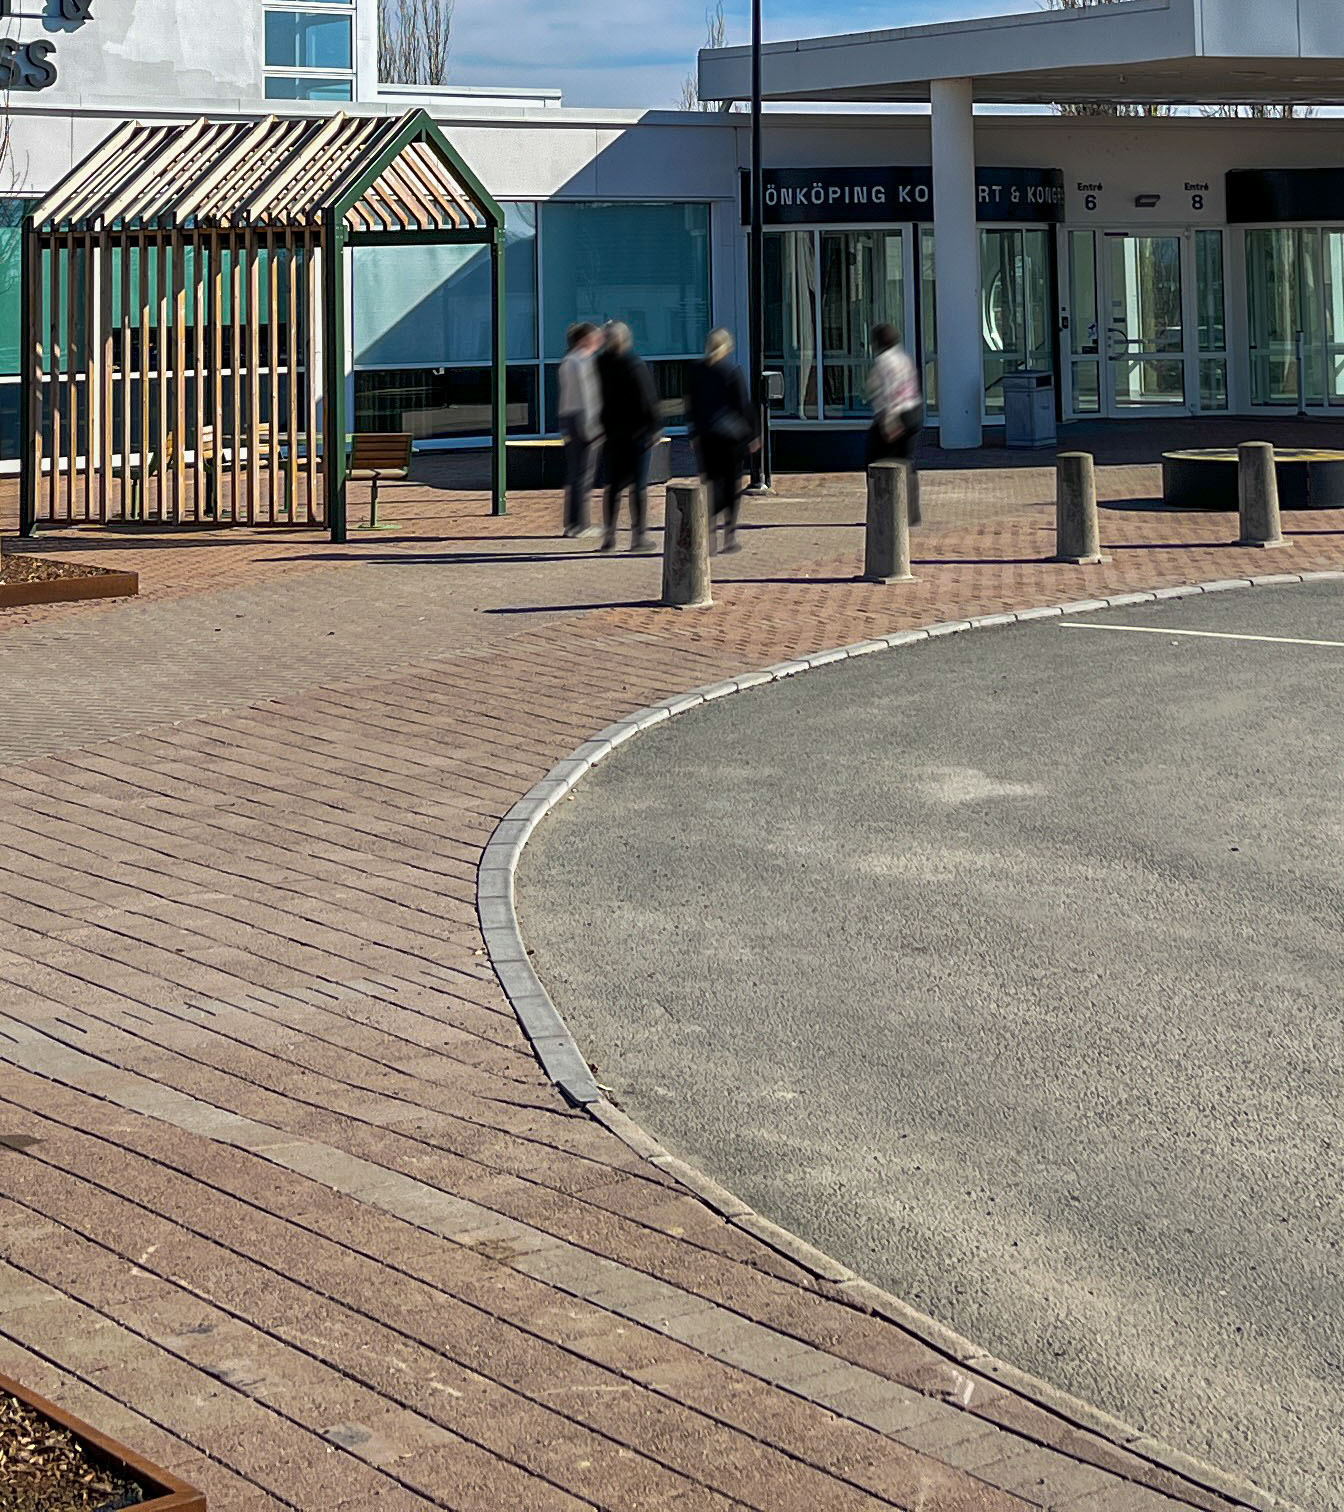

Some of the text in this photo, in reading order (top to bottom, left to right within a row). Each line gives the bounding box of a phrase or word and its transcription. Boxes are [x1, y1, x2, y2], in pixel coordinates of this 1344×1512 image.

[764, 182, 886, 206] ÖNKÖPING
[1010, 186, 1020, 203] &
[1077, 182, 1103, 192] Entré
[1184, 182, 1209, 192] Entré
[1085, 194, 1097, 211] 6
[1191, 194, 1204, 211] 8
